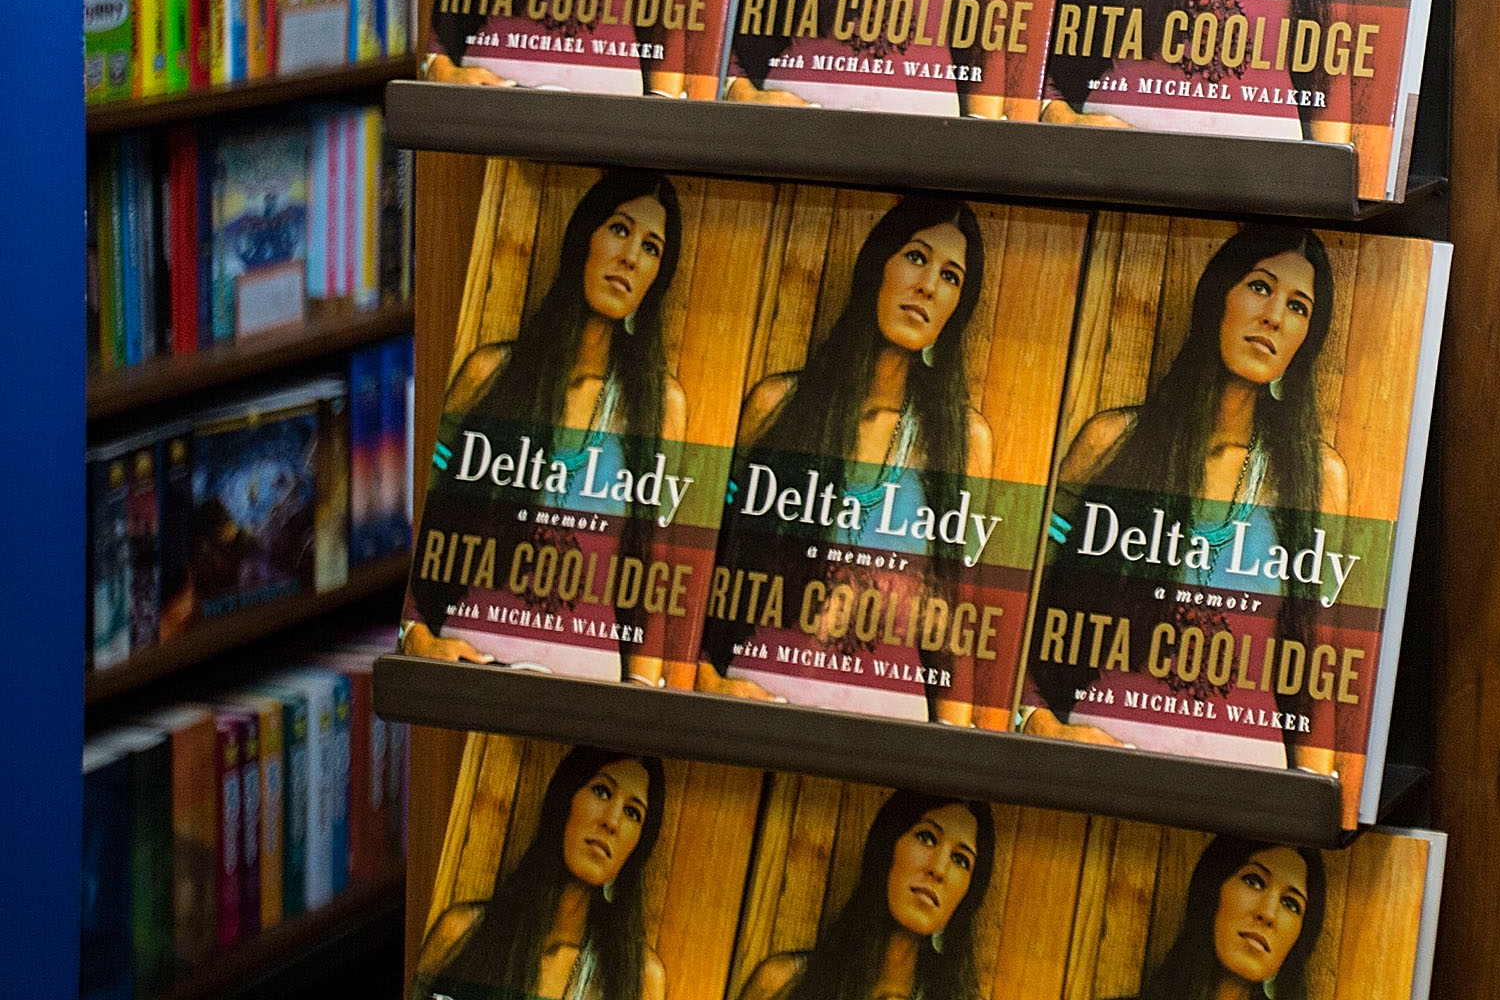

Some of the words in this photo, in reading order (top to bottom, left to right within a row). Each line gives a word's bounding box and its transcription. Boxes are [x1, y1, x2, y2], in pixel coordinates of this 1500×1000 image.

[465, 34, 500, 47] with
[505, 32, 585, 53] MICHAEL
[591, 39, 664, 60] WALKER
[1054, 3, 1143, 61] RITA
[1161, 10, 1380, 78] COOLIDGE
[767, 56, 804, 68] with
[810, 55, 895, 75] MICHAEL
[903, 62, 984, 83] WALKER
[1087, 78, 1129, 92] with
[1137, 78, 1232, 100] MICHAEL
[1240, 85, 1327, 108] WALKER
[454, 430, 567, 494] Delta
[578, 446, 694, 528] Lady
[517, 508, 528, 521] a
[535, 508, 609, 532] memoir
[740, 463, 862, 531] Delta
[875, 482, 1003, 568] Lady
[420, 530, 498, 589] RITA
[509, 540, 693, 617] COOLIDGE
[807, 545, 818, 559] a
[826, 546, 909, 572] memoir
[1077, 502, 1212, 572] Delta
[1226, 520, 1360, 608] Lady
[446, 602, 480, 619] with
[486, 605, 565, 632] MICHAEL
[572, 617, 645, 644] WALKER
[708, 566, 785, 629] RITA
[800, 579, 1004, 661] COOLIDGE
[1154, 586, 1167, 600] a
[1176, 587, 1263, 613] memoir
[732, 641, 769, 659] with
[776, 645, 865, 675] MICHAEL
[872, 659, 952, 688] WALKER
[1039, 607, 1132, 673] RITA
[1149, 622, 1365, 705] COOLIDGE
[1074, 686, 1115, 704] with
[1124, 690, 1217, 720] MICHAEL
[1226, 704, 1312, 733] WALKER
